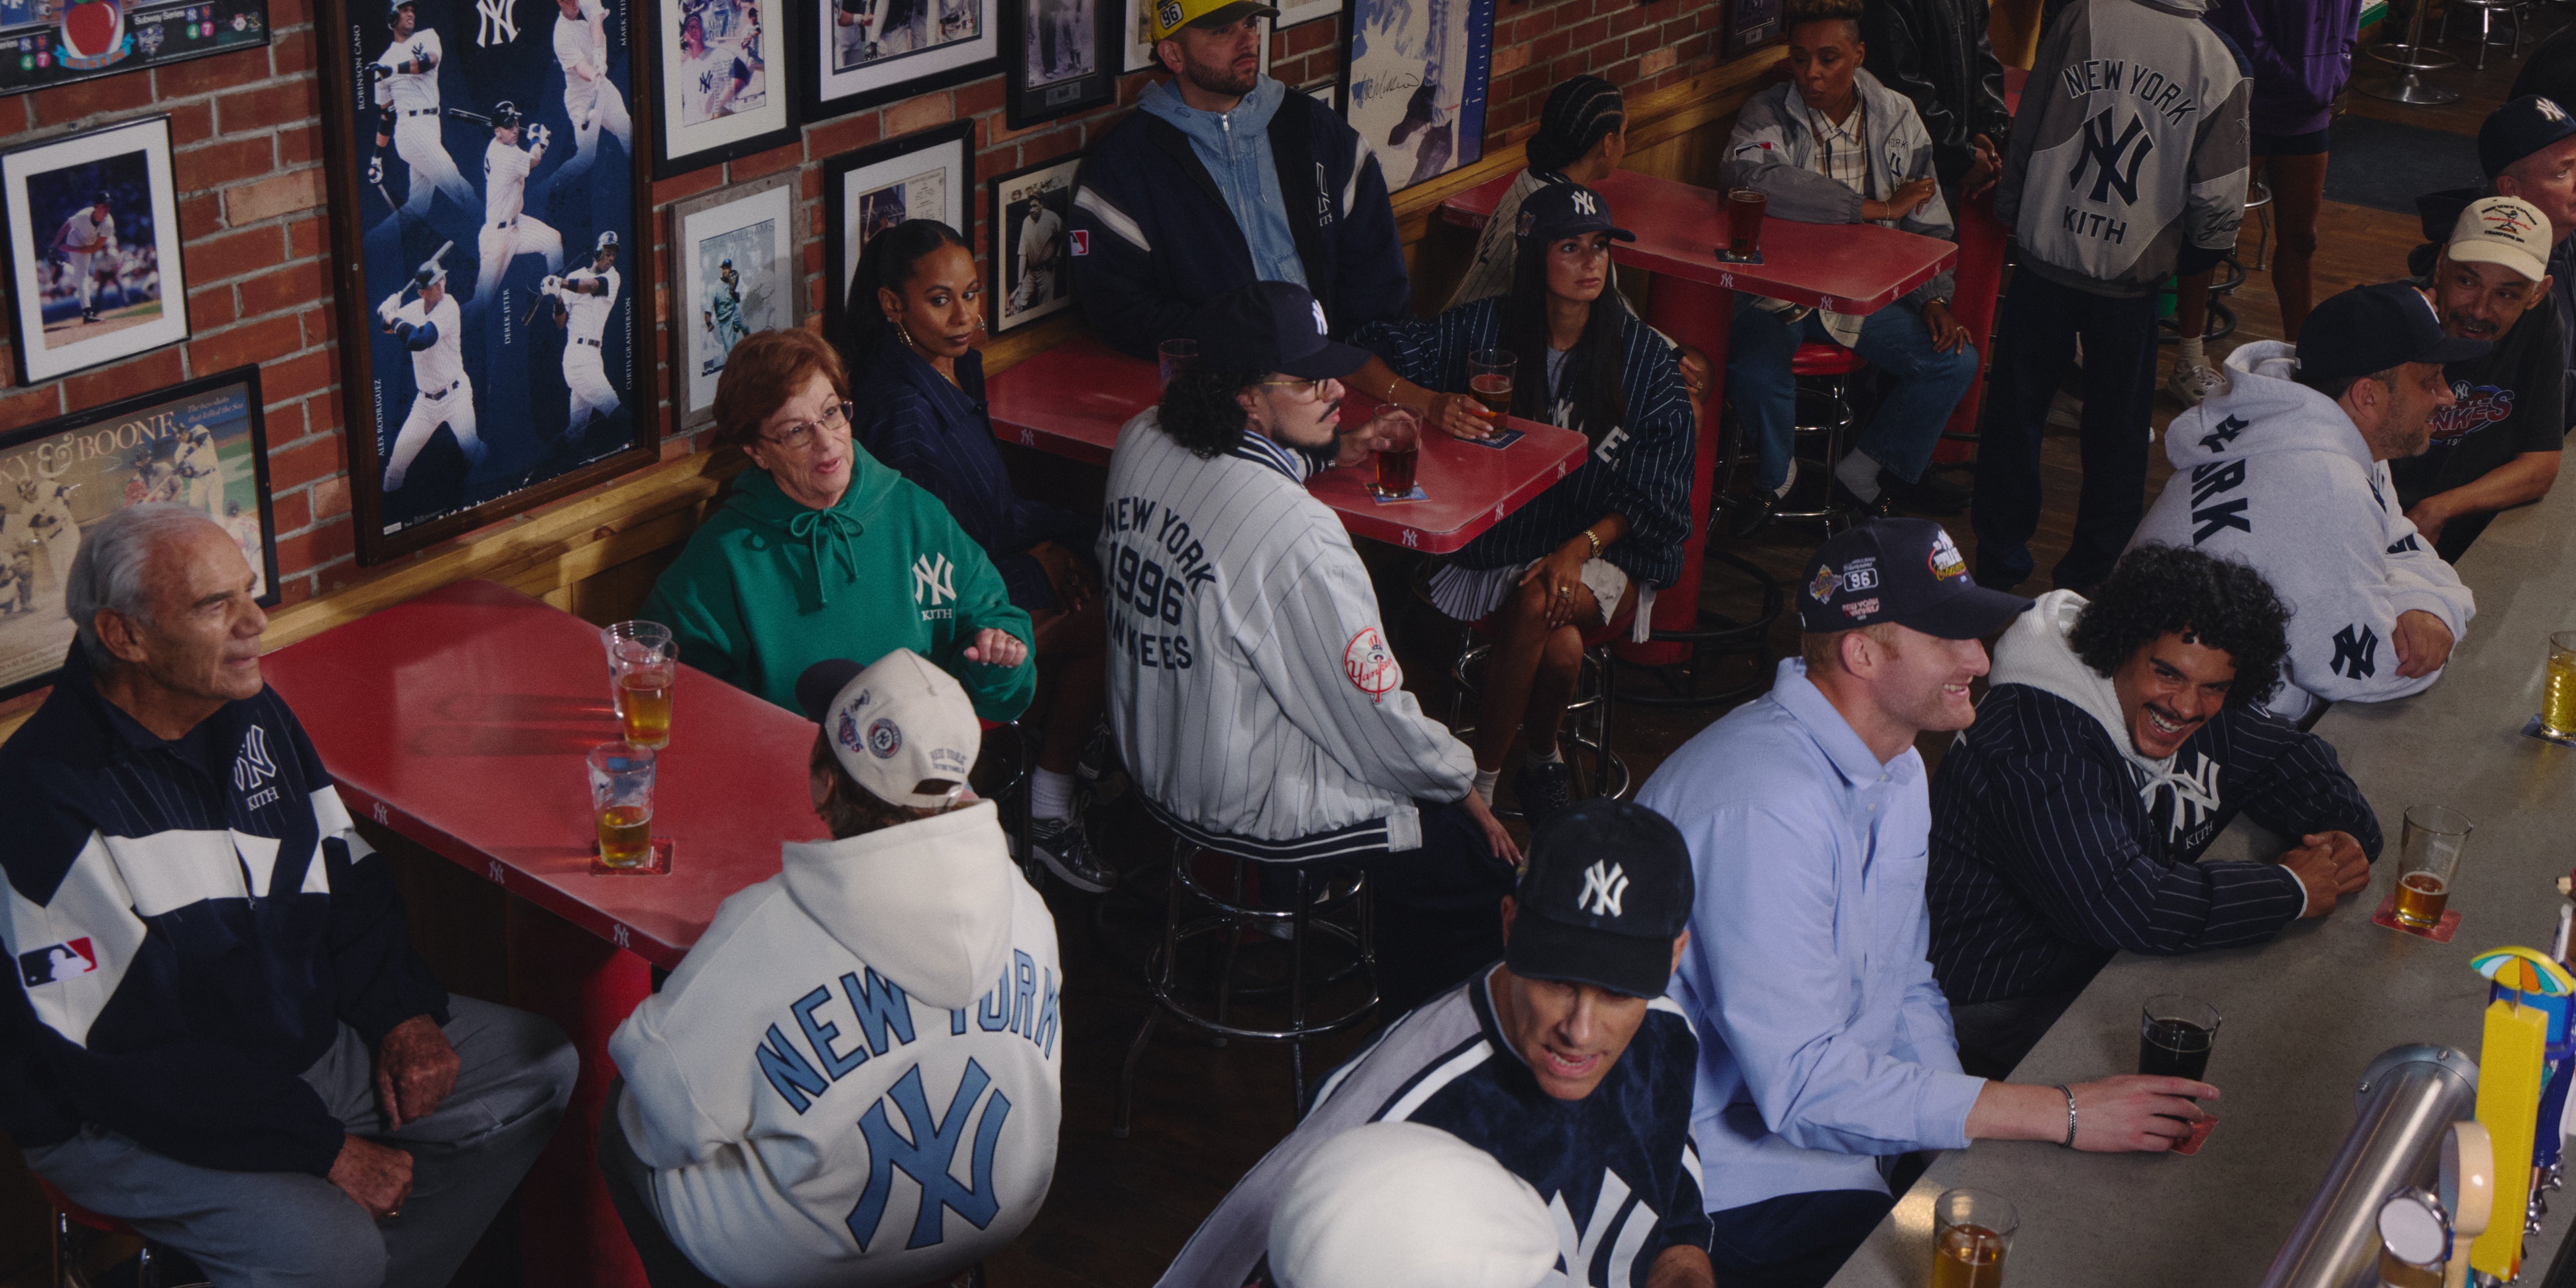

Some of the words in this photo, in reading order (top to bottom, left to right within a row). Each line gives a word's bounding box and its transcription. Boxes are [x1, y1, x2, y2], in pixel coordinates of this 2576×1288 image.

[135, 15, 162, 26] Subway
[163, 10, 185, 21] Series
[353, 25, 362, 56] CANO
[1161, 5, 1180, 26] 96
[356, 56, 367, 111] ROBINSON
[2062, 59, 2124, 99] NEW
[2128, 64, 2197, 128] YORK
[1888, 138, 1908, 150] ORK
[2068, 103, 2155, 208] NY
[1571, 190, 1597, 216] NY
[2063, 205, 2128, 246] KITH
[374, 379, 385, 431] RODRIGUEZ
[37, 433, 74, 478] &
[77, 411, 175, 462] BOONE
[2191, 456, 2252, 553] ORK
[1105, 497, 1156, 539] NEW
[1157, 507, 1217, 595] YORK
[912, 551, 957, 606] NY
[1109, 540, 1186, 626] 1996
[922, 608, 953, 621] KITH
[1105, 588, 1193, 670] ANKEES
[247, 786, 280, 811] KITH
[2185, 820, 2214, 850] KITH
[1577, 859, 1629, 917] NY
[755, 965, 916, 1116] NEW
[845, 1056, 1012, 1254] NY
